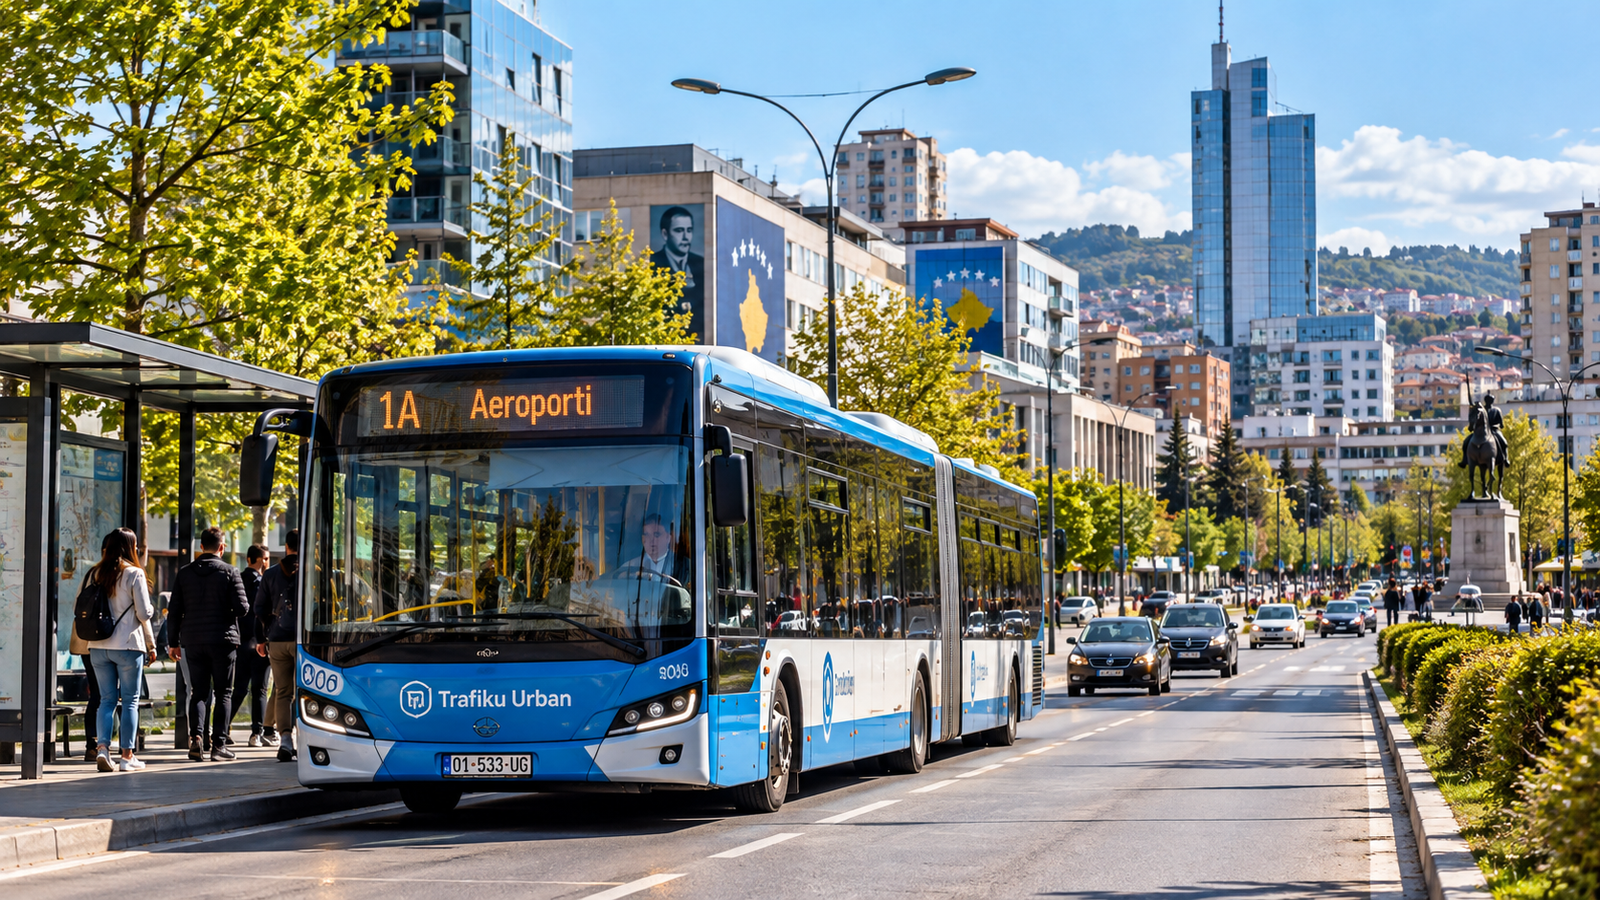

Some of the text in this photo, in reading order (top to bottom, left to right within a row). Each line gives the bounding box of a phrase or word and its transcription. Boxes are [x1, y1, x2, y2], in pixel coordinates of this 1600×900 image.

[379, 384, 592, 429] 1A Aeroporti
[438, 689, 572, 708] Trafiku Urban
